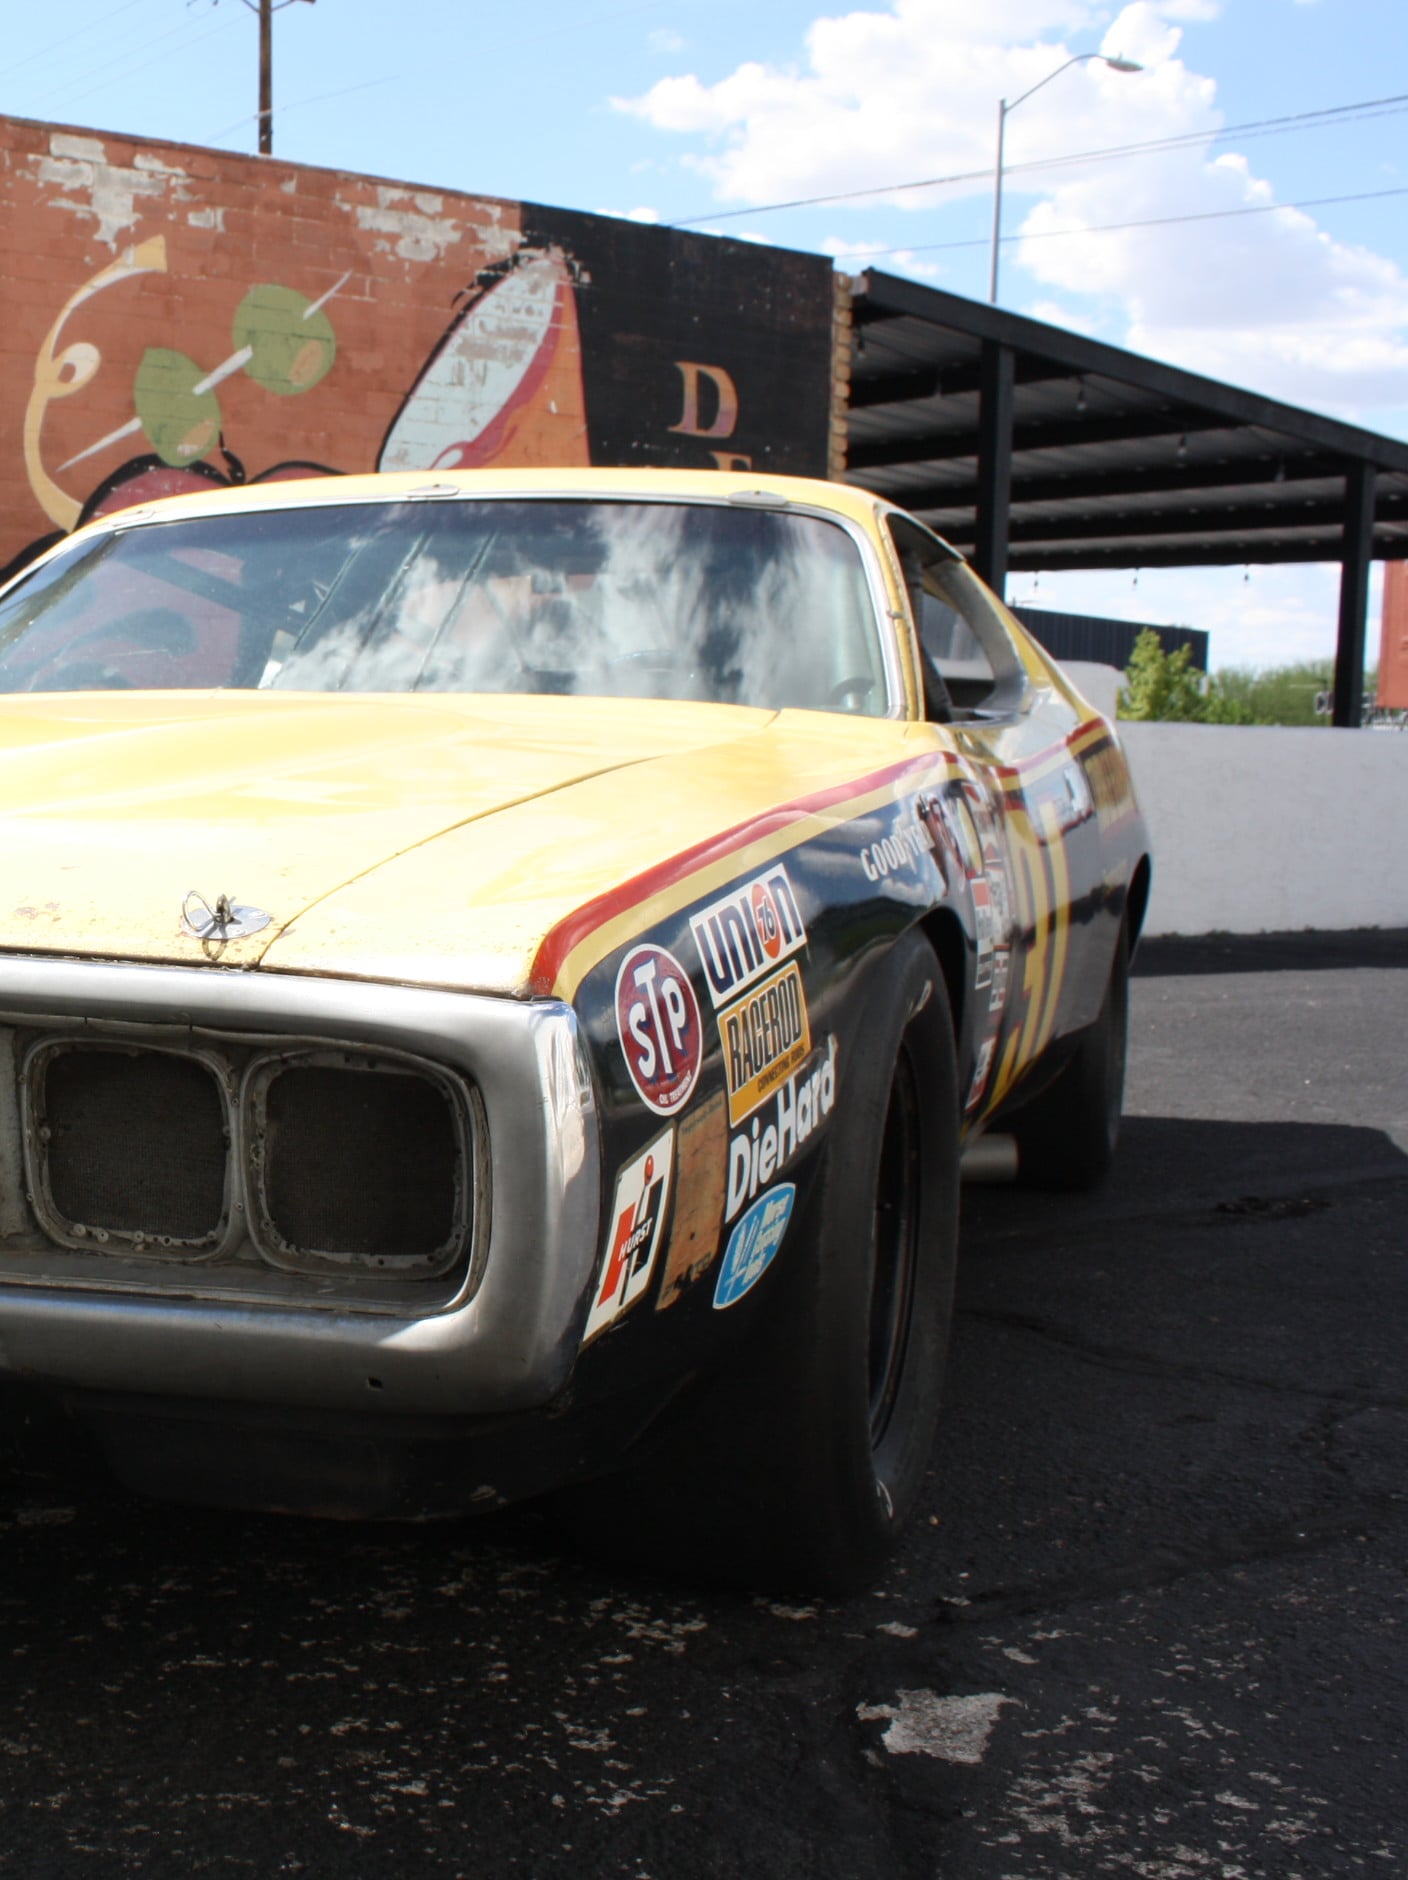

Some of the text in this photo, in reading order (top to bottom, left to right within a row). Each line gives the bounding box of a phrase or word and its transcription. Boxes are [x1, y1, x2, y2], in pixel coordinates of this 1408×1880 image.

[667, 361, 739, 438] D
[629, 958, 686, 1078] STP
[726, 971, 802, 1096] RACEROD
[725, 1033, 838, 1224] DieHard
[618, 1217, 653, 1262] HURST
